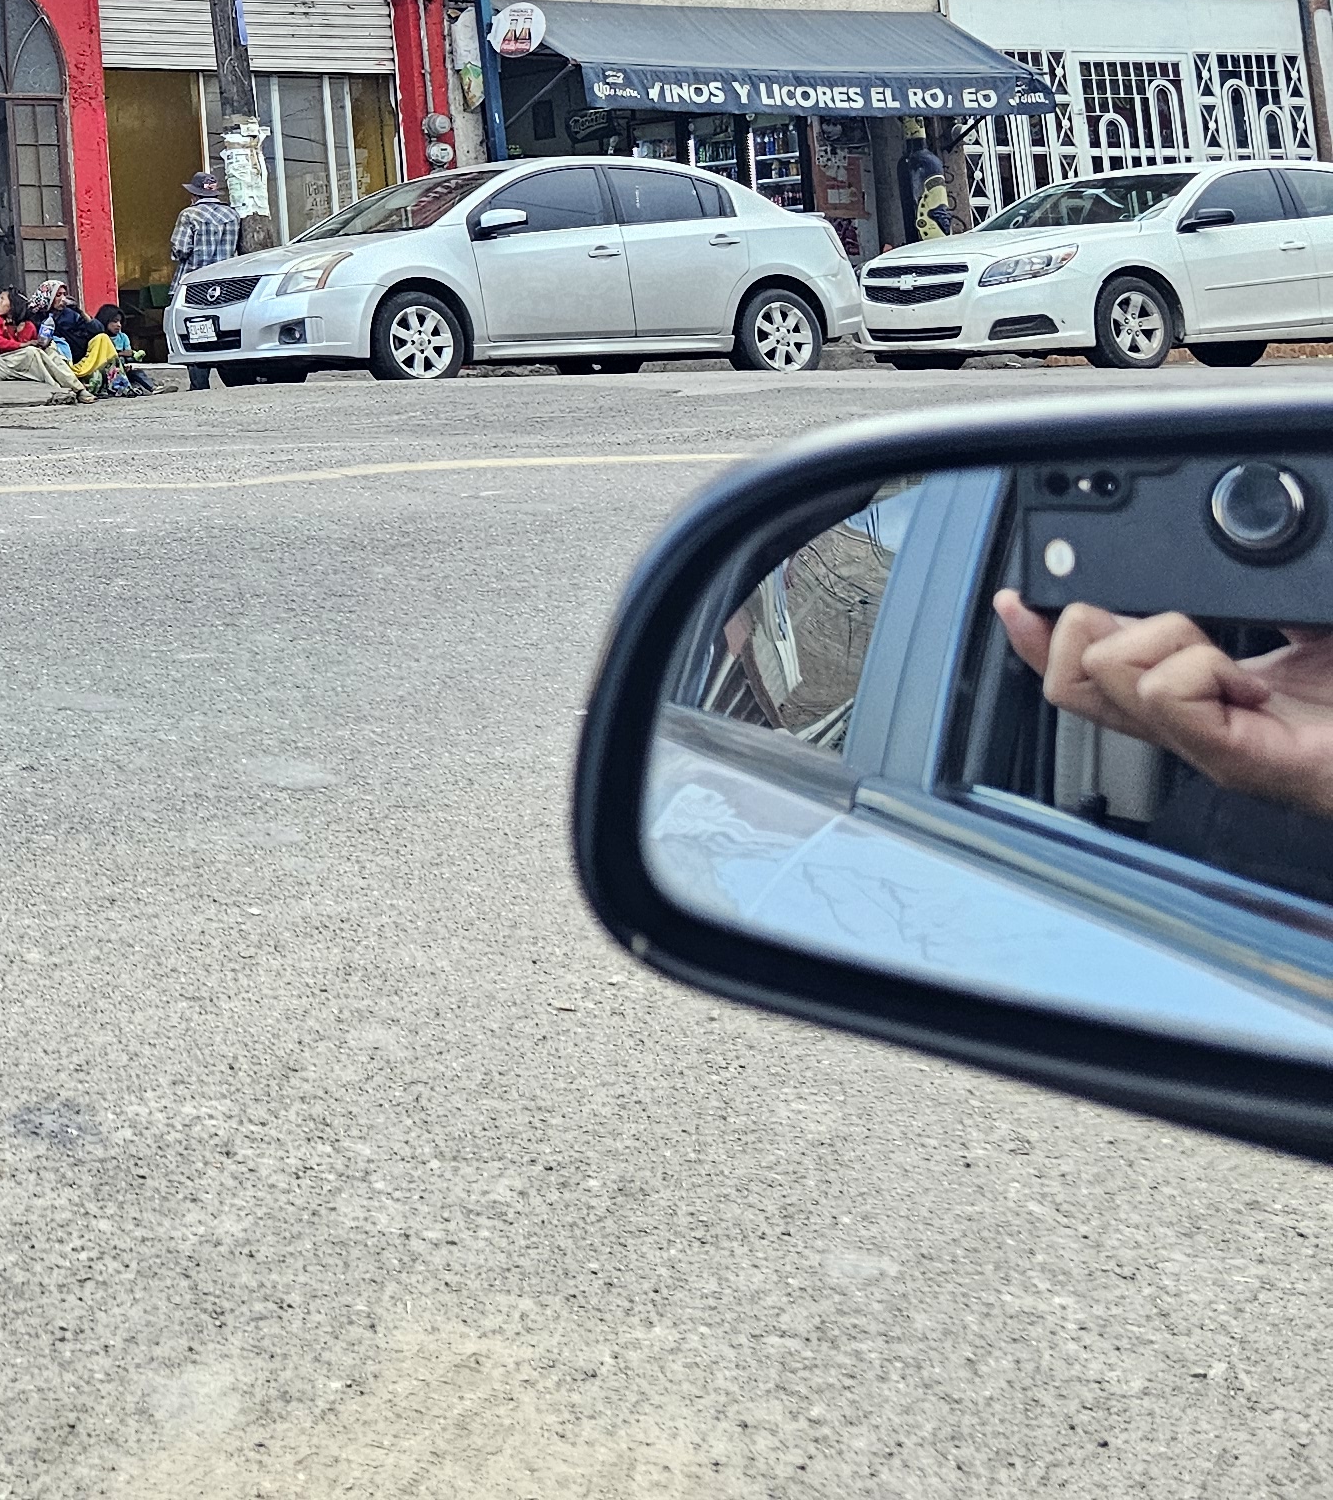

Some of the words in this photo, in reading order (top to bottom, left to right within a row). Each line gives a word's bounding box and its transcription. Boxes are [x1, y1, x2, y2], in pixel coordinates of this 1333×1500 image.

[731, 82, 751, 104] Y
[760, 82, 864, 109] LICORES
[870, 87, 901, 109] EL
[908, 87, 998, 109] ROEO
